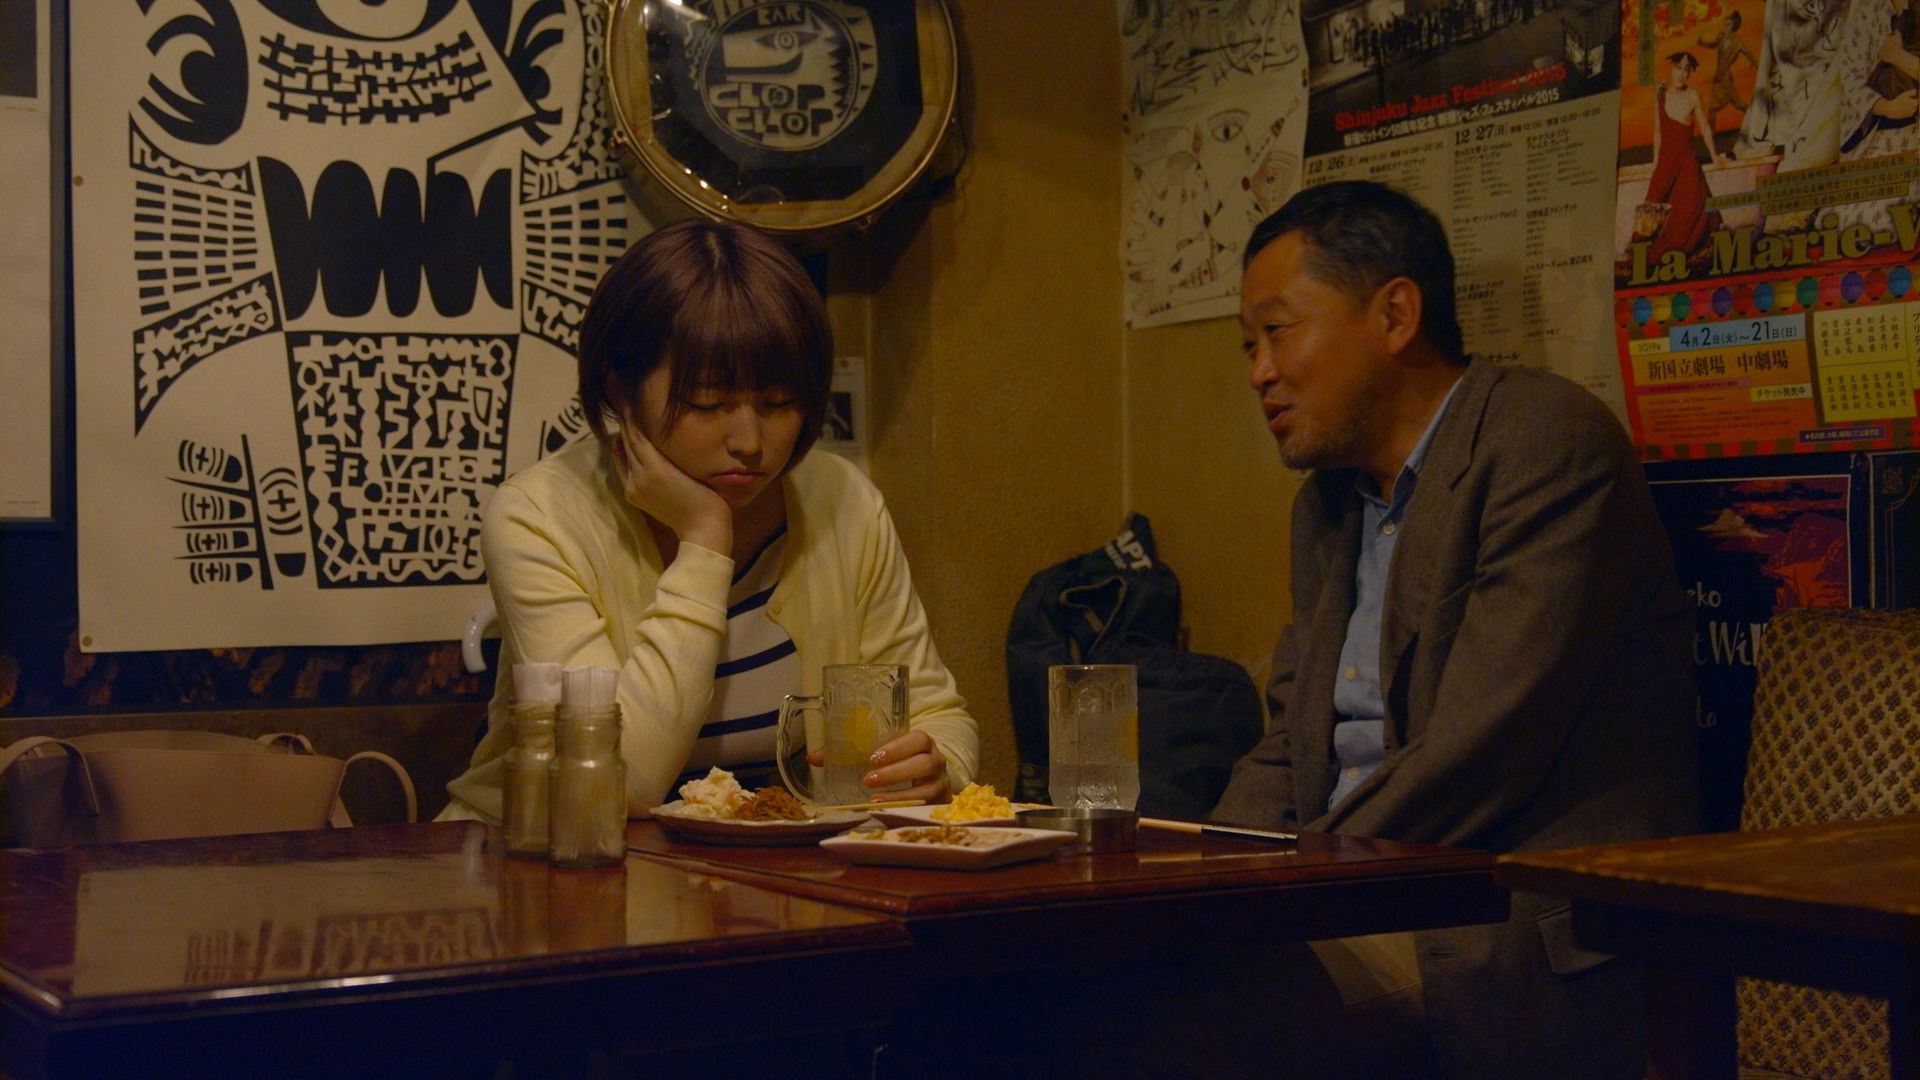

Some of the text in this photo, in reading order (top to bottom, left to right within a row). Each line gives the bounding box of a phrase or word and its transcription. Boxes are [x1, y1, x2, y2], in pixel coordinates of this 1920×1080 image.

[709, 83, 826, 111] CLOP
[1334, 101, 1408, 132] Shinjuku
[1409, 93, 1449, 114] Jazz
[1451, 72, 1520, 105] Festival
[727, 108, 834, 137] CLOP
[1455, 129, 1470, 146] 12
[1475, 124, 1495, 141] 27
[1308, 159, 1323, 175] 12
[1327, 154, 1345, 171] 26
[1627, 241, 1690, 287] La
[1647, 348, 1789, 381] 新国立劇場 中劇場
[1756, 387, 1806, 399] チケット発売中
[1709, 620, 1767, 668] Wil
